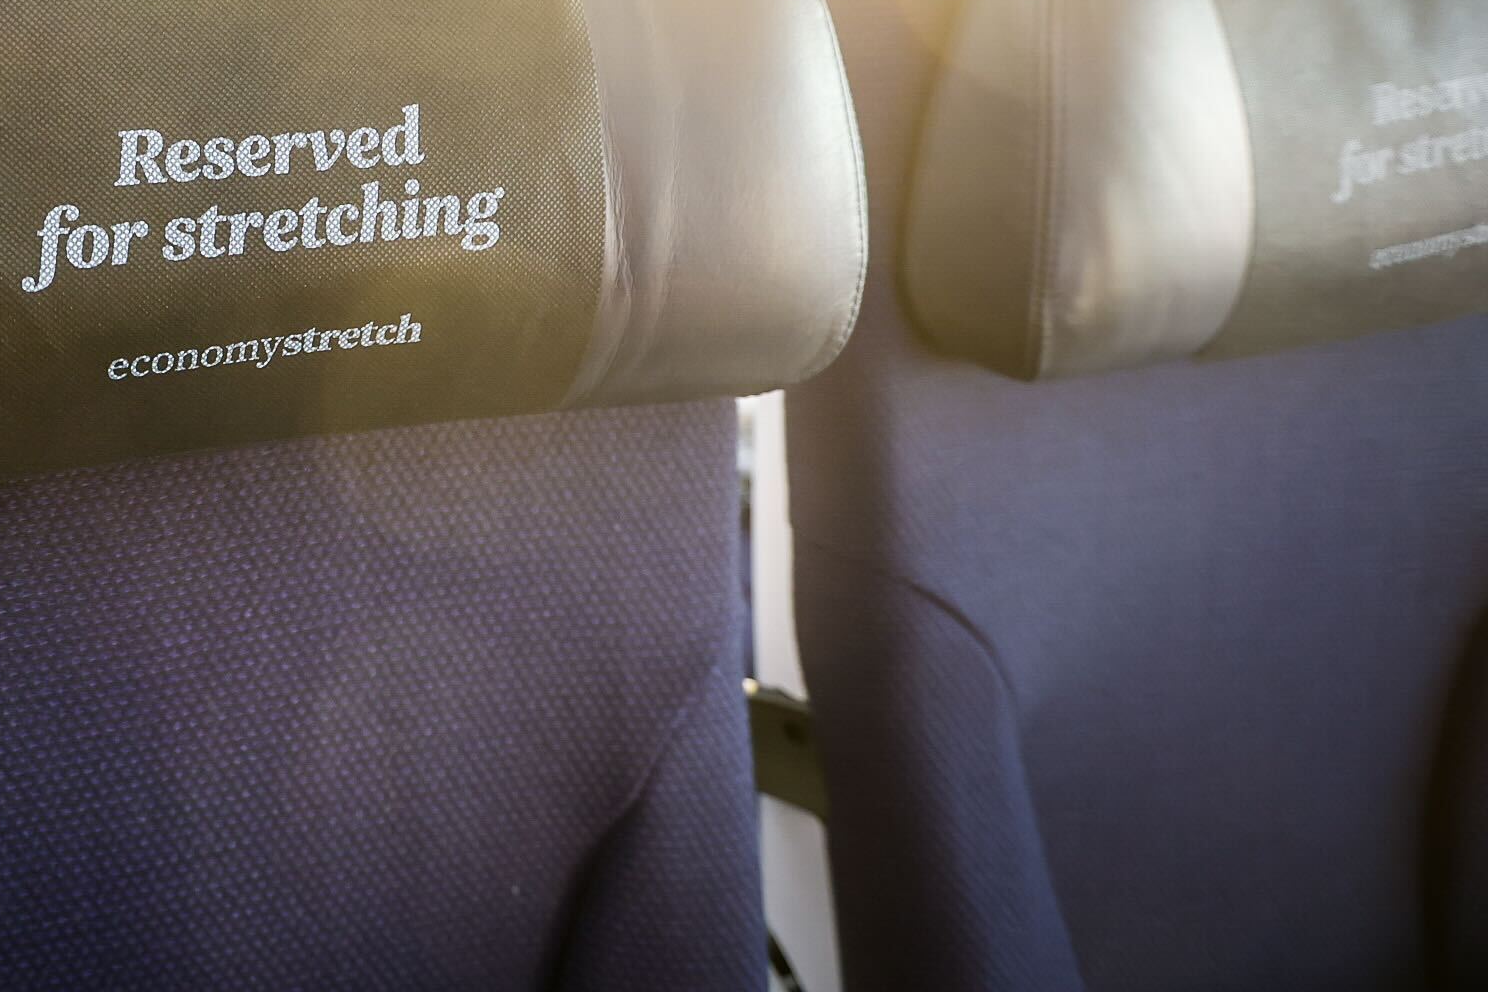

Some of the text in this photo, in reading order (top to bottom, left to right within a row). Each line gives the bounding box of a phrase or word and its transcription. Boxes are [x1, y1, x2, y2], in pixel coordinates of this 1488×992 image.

[113, 103, 425, 187] Reserved
[20, 178, 505, 293] for stretching
[106, 312, 423, 381] economystretch
